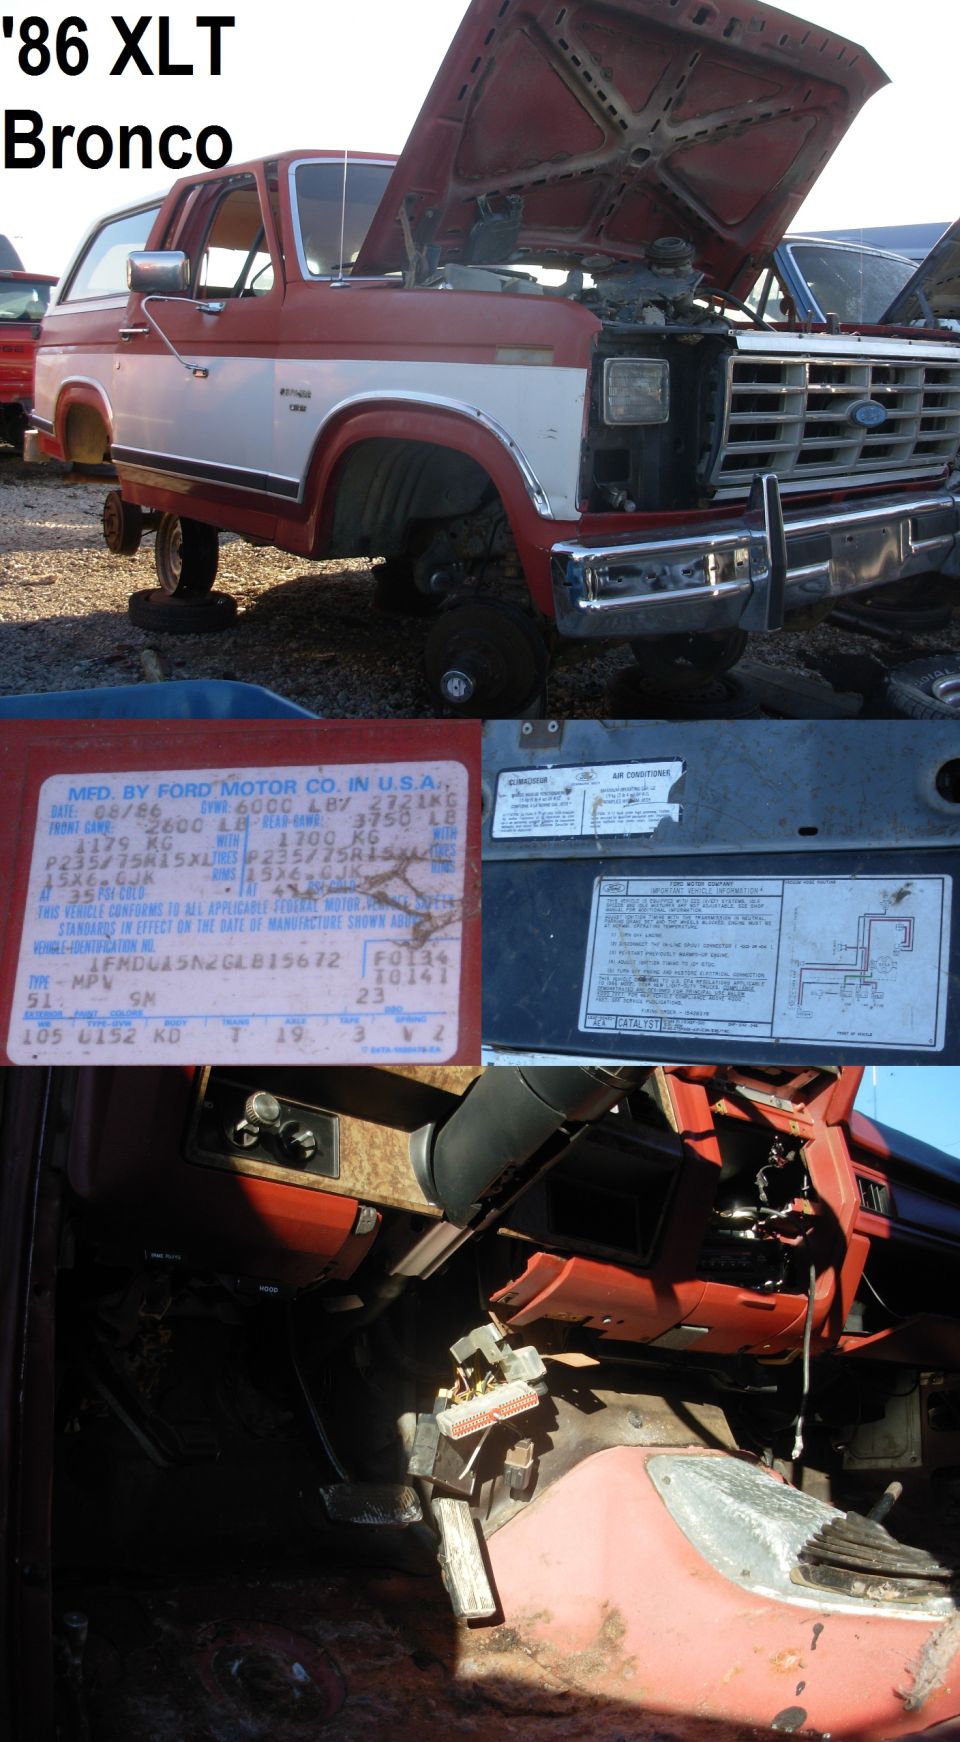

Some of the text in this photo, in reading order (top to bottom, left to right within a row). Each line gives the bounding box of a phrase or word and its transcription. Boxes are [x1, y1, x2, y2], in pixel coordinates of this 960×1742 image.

[627, 769, 671, 779] CONDITIONER
[69, 787, 115, 800] MFD.
[123, 784, 149, 799] BY
[158, 783, 212, 798] FORD
[221, 780, 297, 796] MOTOR
[306, 779, 341, 793] CO.
[349, 777, 369, 792] IN
[94, 803, 162, 819] 08/86
[352, 810, 411, 829] 3750
[428, 809, 456, 826] LB
[49, 821, 79, 835] FRONT
[145, 817, 203, 834] 2600
[218, 816, 247, 832] LB
[75, 833, 240, 854] 1179 KG WITH
[279, 827, 458, 847] 1700 KG WITH
[212, 851, 238, 865] TIRES
[212, 867, 236, 881] RIMS
[68, 889, 96, 905] 35
[120, 886, 145, 900] COLD
[39, 905, 60, 919] THIS
[65, 904, 104, 918] VEHICLE
[109, 902, 163, 917] CONFORMS
[168, 902, 179, 916] TO
[185, 902, 203, 916] ALL
[208, 900, 268, 915] APPLICABLE
[274, 898, 319, 914] FEDERAL
[325, 896, 360, 912] MOTOR
[58, 914, 422, 936] STANDARDS IN EFFECT ON THE DATE OF MANUFACTURE SHOWN ABOV
[33, 940, 66, 954] VEHICLE
[70, 939, 137, 954] IDENTIFICATION
[29, 974, 113, 990] TYPE MPV
[355, 987, 384, 1004] 23
[618, 1018, 660, 1029] CATALYST
[23, 1028, 63, 1045] 105
[153, 1028, 181, 1044] KD
[259, 1285, 279, 1293] HOOD
